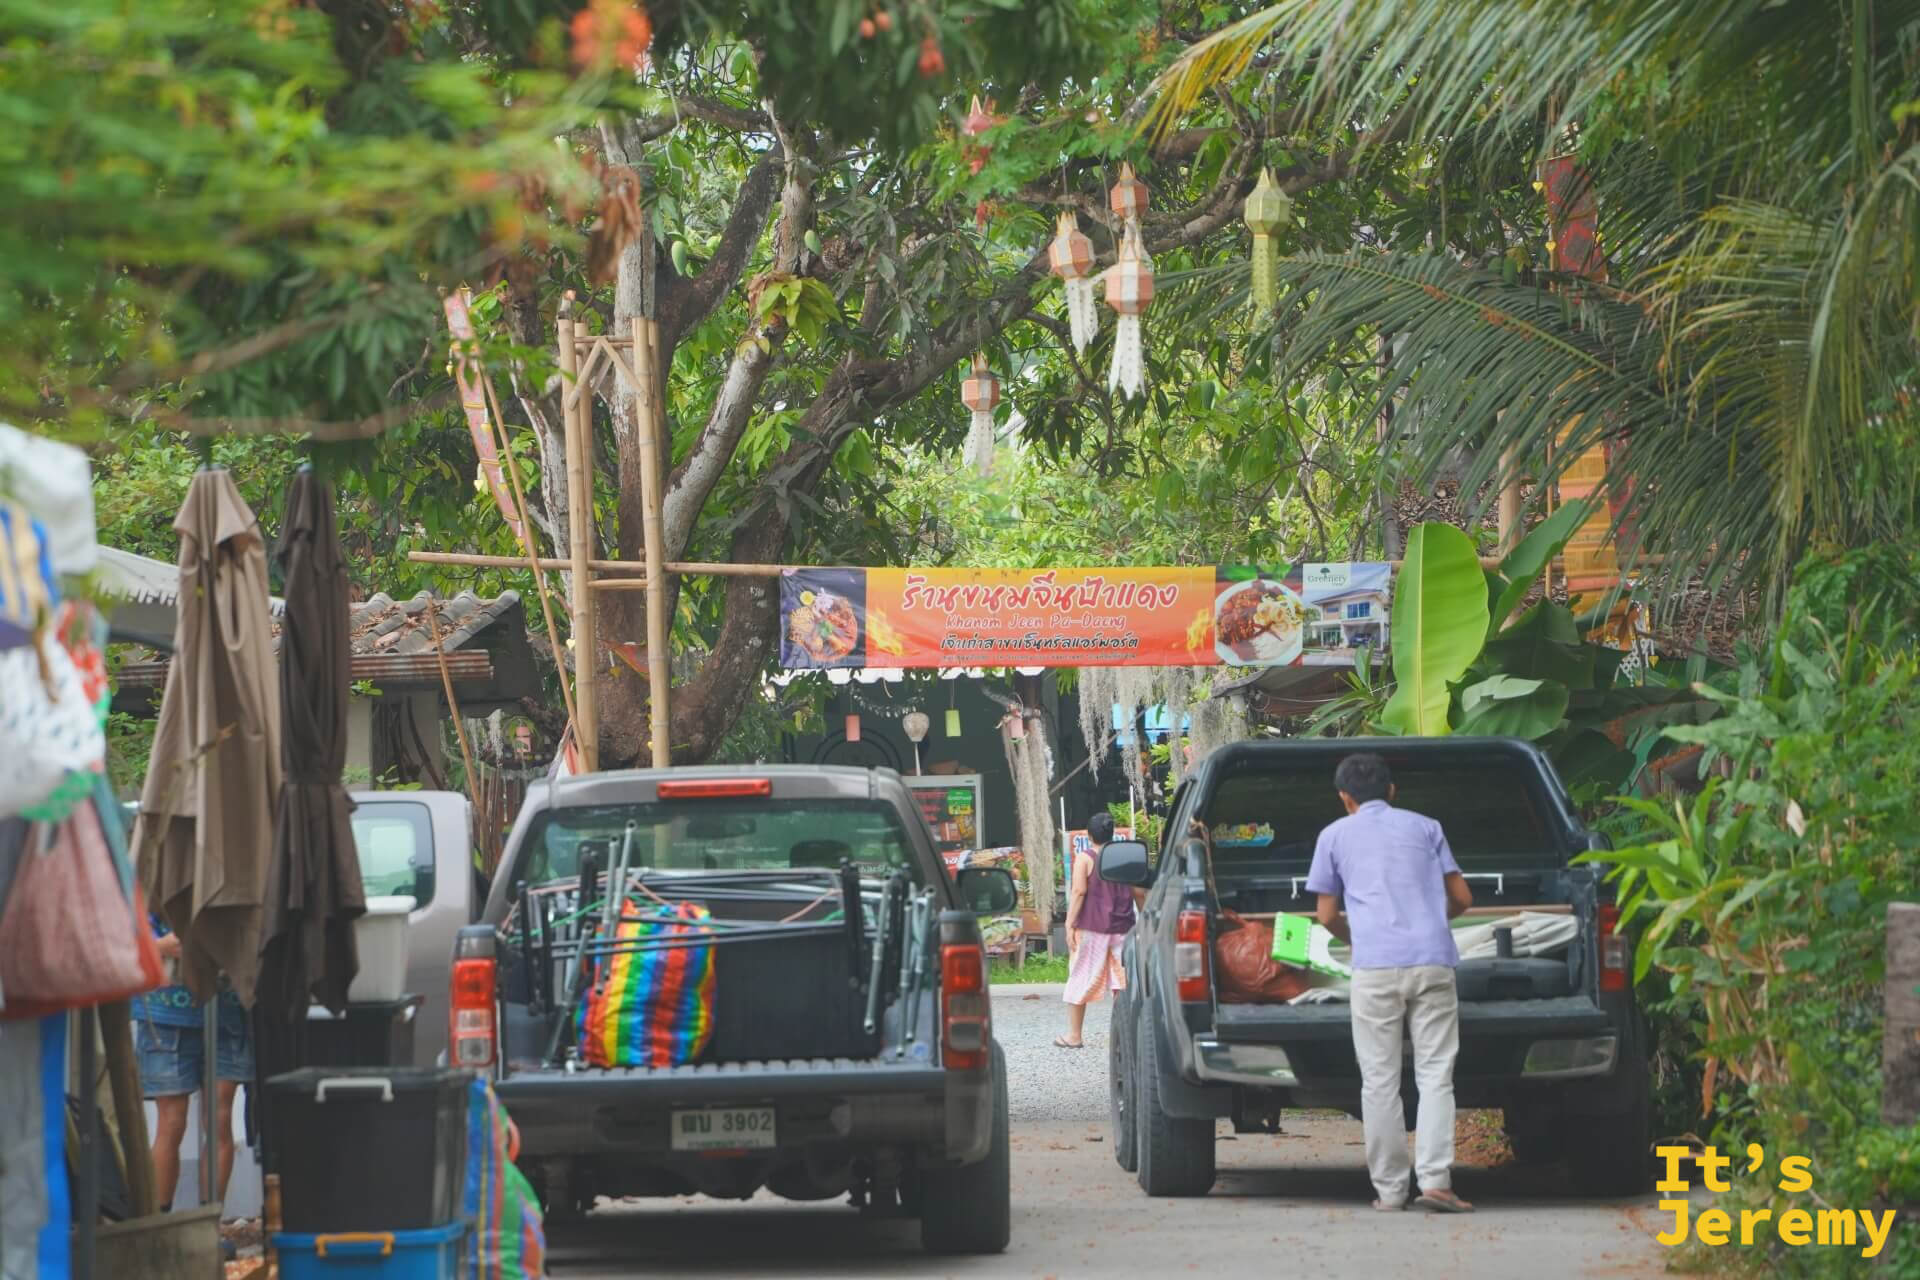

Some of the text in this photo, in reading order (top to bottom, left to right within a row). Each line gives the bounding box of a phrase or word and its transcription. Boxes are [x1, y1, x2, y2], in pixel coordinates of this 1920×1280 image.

[945, 614, 1001, 628] Khanom
[1008, 613, 1043, 628] Jeen
[722, 1111, 772, 1131] 3902
